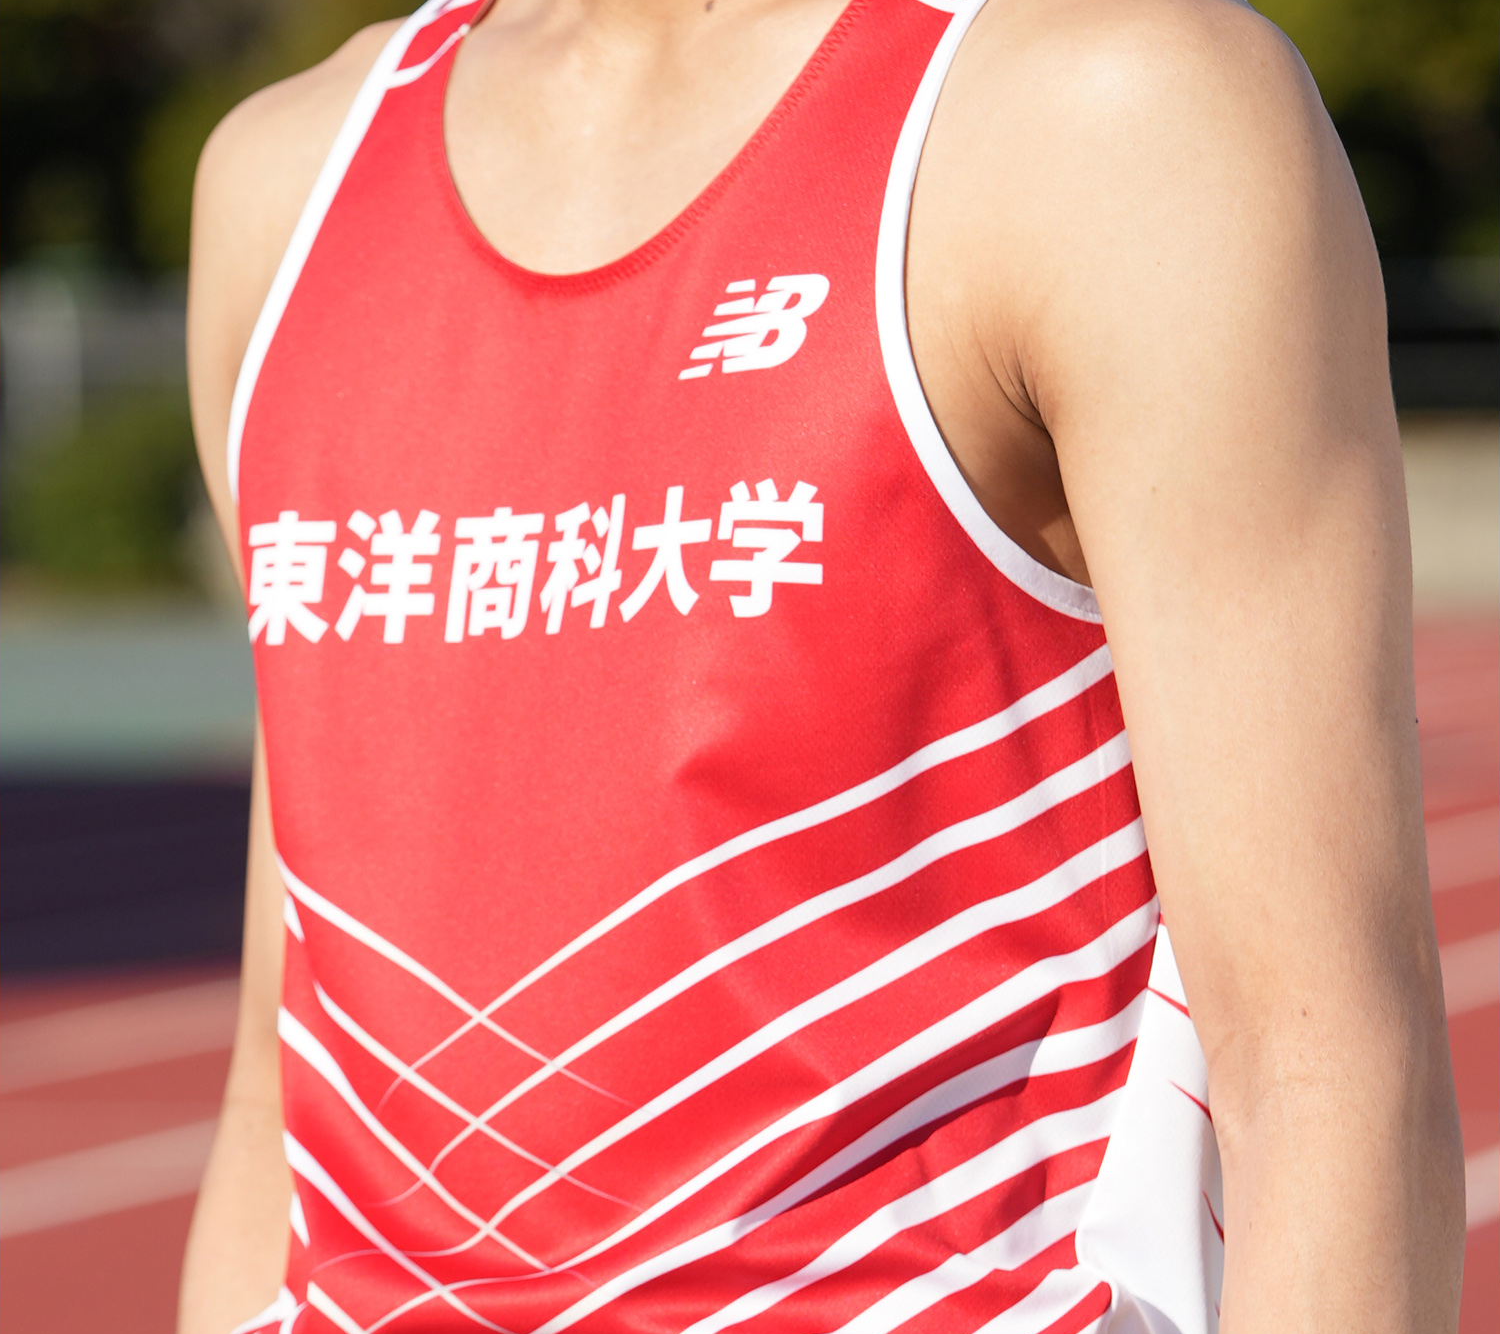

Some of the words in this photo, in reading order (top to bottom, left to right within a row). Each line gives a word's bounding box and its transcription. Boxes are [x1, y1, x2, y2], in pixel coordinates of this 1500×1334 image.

[247, 476, 825, 647] 東洋商科大学
